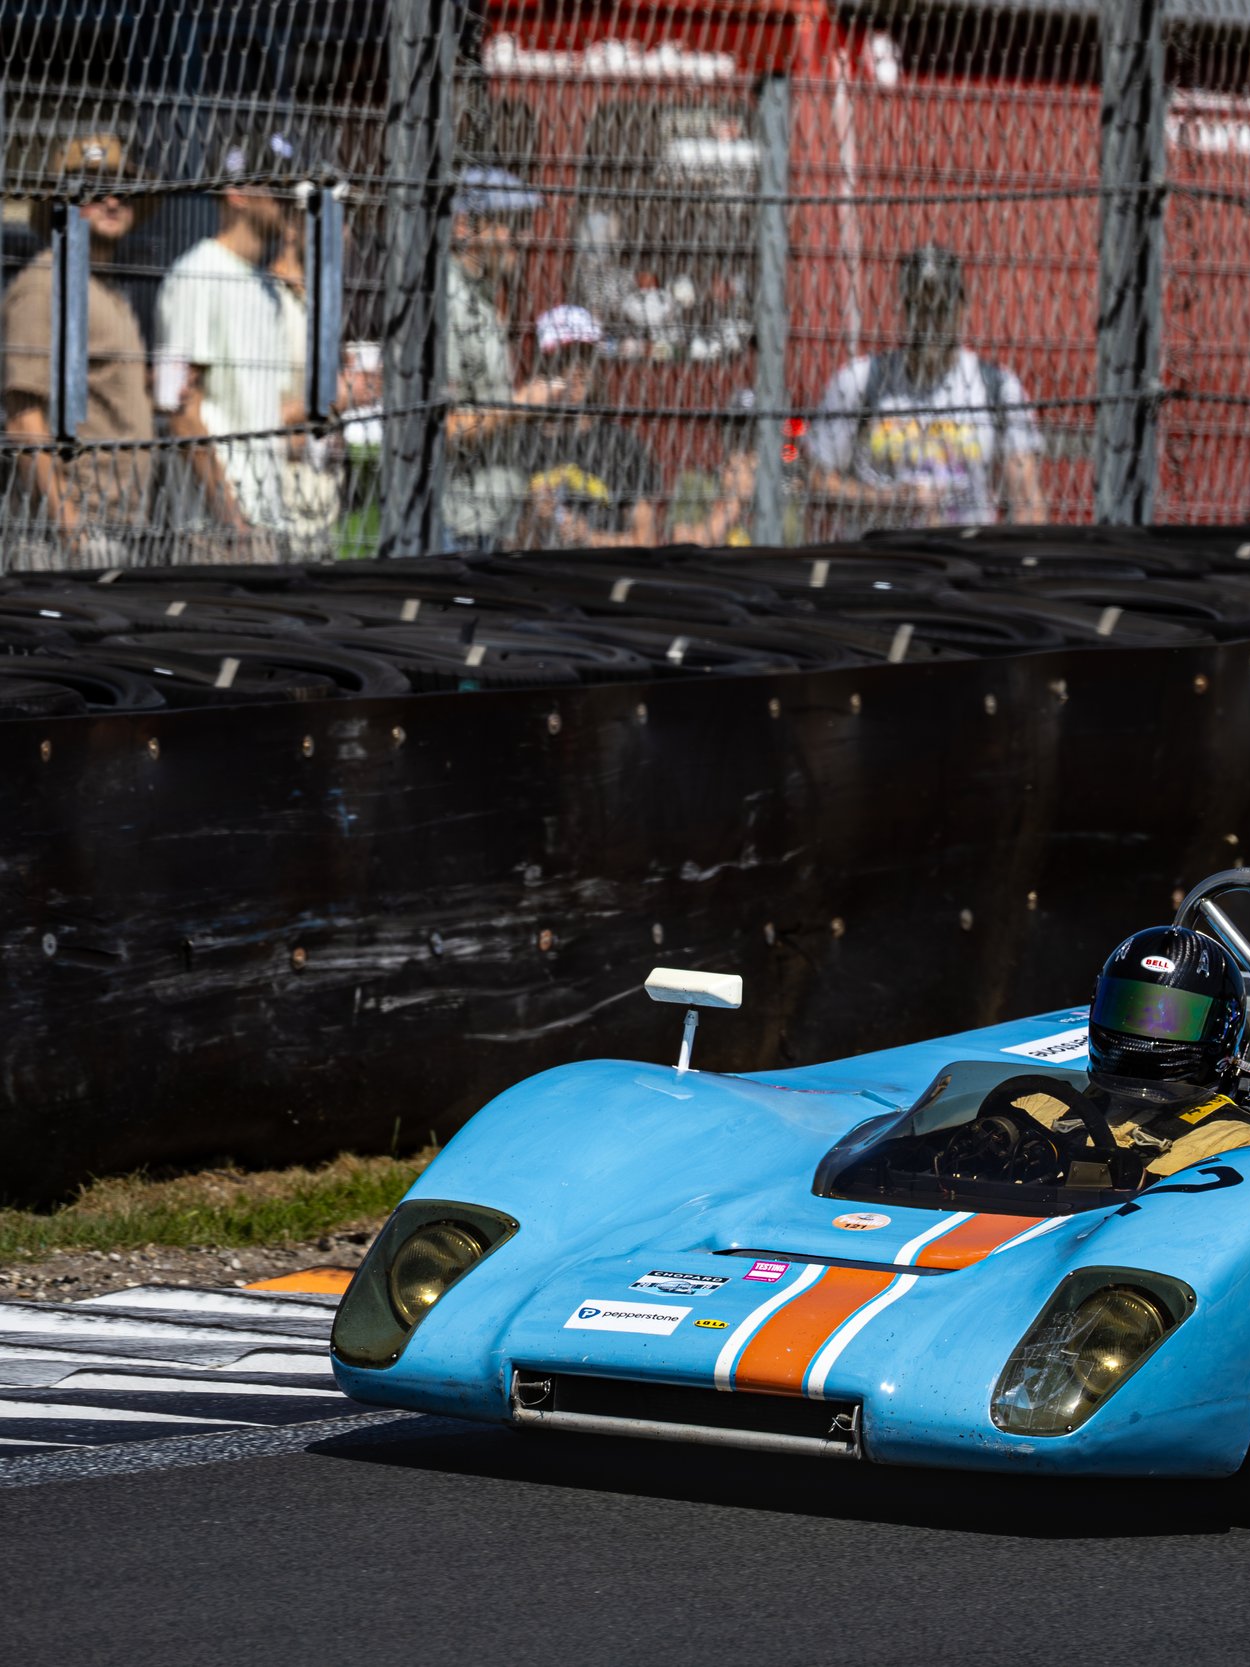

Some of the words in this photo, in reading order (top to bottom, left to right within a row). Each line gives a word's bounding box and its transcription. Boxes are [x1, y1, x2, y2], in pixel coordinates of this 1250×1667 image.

[1145, 958, 1169, 969] BELL
[754, 1262, 786, 1272] TESTING
[654, 1271, 723, 1283] CHOPARD
[602, 1310, 679, 1322] pepperstone
[696, 1320, 725, 1328] LOLA
